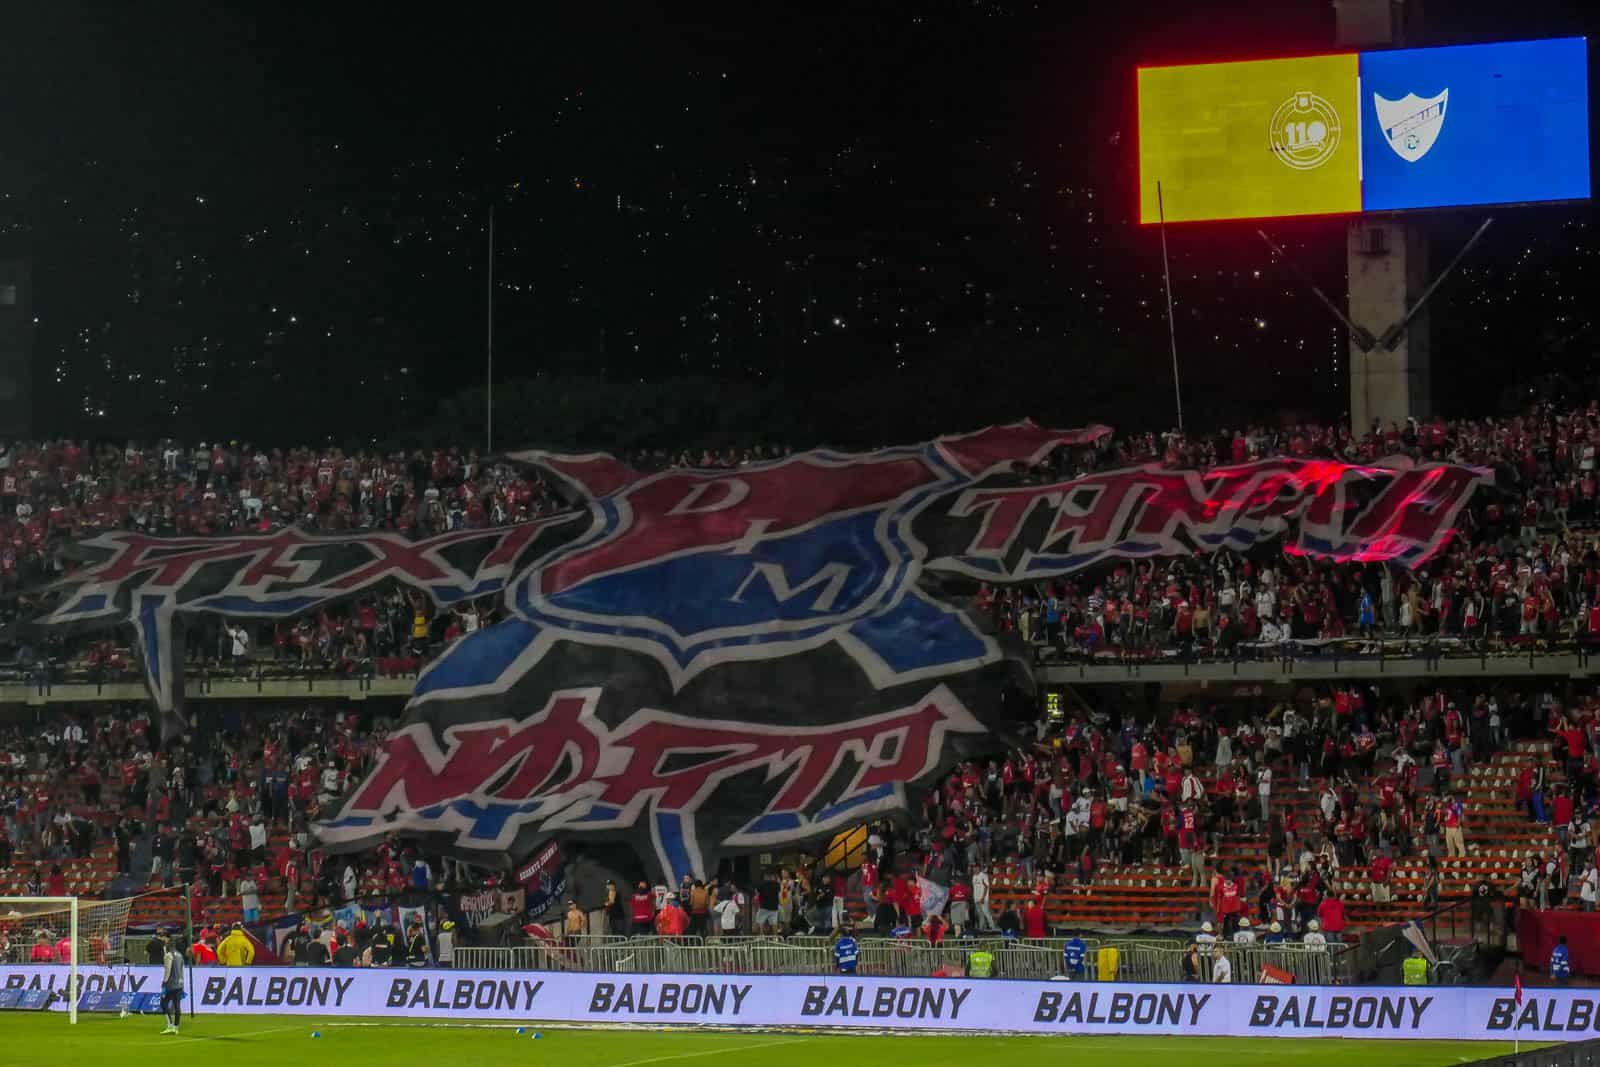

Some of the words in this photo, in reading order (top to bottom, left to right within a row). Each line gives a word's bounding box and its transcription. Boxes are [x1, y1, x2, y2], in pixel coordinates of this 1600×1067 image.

[202, 976, 353, 1007] BALBONY
[386, 979, 543, 1010] BALBONY
[589, 983, 752, 1014] BALBONY
[801, 986, 971, 1019] BALBONY
[1034, 992, 1210, 1025] BALBONY
[1249, 996, 1433, 1029] BALBONY
[1486, 998, 1600, 1031] BALB
